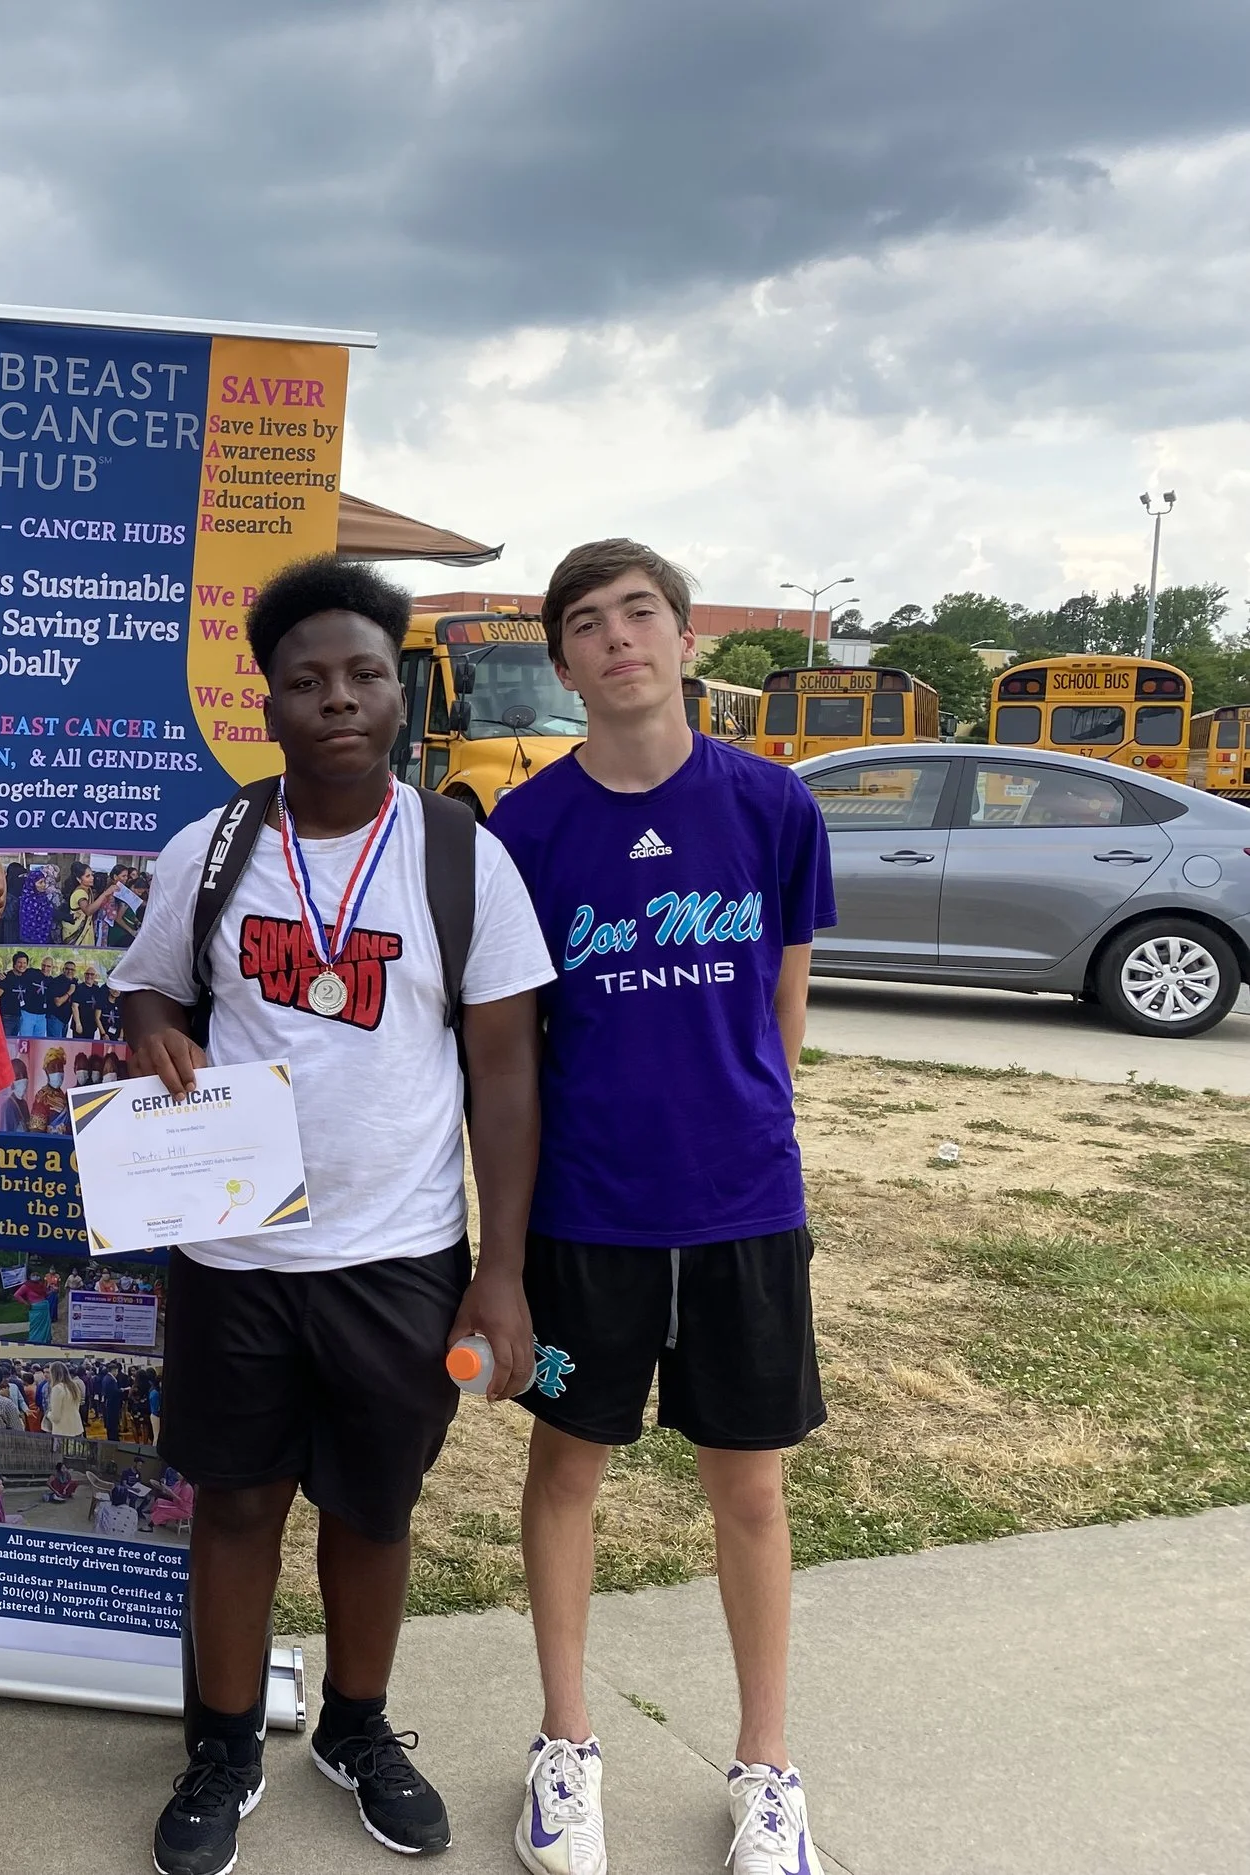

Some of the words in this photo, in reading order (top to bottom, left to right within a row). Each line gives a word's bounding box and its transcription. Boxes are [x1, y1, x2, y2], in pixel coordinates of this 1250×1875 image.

[0, 352, 188, 401] BREAST
[221, 375, 325, 408] SAVER
[209, 415, 254, 435] Save
[259, 417, 307, 438] lives
[313, 419, 338, 444] by
[205, 440, 316, 462] Awareness
[204, 464, 337, 492] Volunteering
[202, 489, 306, 511] Education
[19, 517, 117, 542] CANCER
[122, 522, 186, 545] HUBS
[199, 513, 293, 534] Research
[21, 569, 185, 603] Sustainable
[195, 584, 235, 607] We
[2, 608, 101, 646] Saving
[106, 613, 180, 642] Lives
[199, 619, 239, 641] We
[487, 622, 547, 641] SCHOOL
[800, 675, 844, 689] SCHOOL
[850, 675, 872, 689] BUS
[1053, 673, 1100, 689] SCHOOL
[1104, 673, 1130, 689] BUS
[194, 686, 234, 708] We
[64, 717, 157, 739] CANCER
[163, 720, 186, 740] in
[29, 748, 46, 767] &
[51, 748, 81, 767] All
[87, 749, 203, 772] GENDERS.
[83, 780, 161, 803] against
[15, 809, 46, 828] OF
[51, 810, 157, 832] CANCERS
[203, 799, 250, 890] HEAD
[629, 844, 673, 859] adidas
[563, 904, 638, 971] Cox
[646, 890, 763, 946] Mill
[595, 961, 735, 994] TENNIS
[322, 984, 334, 1000] 2
[131, 1086, 232, 1113] CERTICATE
[134, 1112, 147, 1120] OF
[44, 1150, 63, 1172] a
[0, 1174, 67, 1198] bridge
[27, 1199, 59, 1217] the
[36, 1222, 87, 1242] Deve
[7, 1534, 23, 1546] All
[26, 1538, 46, 1548] our
[48, 1540, 94, 1554] services
[97, 1546, 115, 1556] are
[118, 1546, 141, 1559] free
[143, 1551, 157, 1562] of
[158, 1554, 182, 1565] cost
[39, 1554, 80, 1569] strictly
[82, 1557, 120, 1572] driven
[122, 1565, 169, 1579] towards
[2, 1586, 49, 1602] 501(c)(3)
[52, 1592, 109, 1607] Nonprofit
[56, 1578, 107, 1594] Platinum
[110, 1585, 161, 1601] Certified
[164, 1592, 174, 1602] &
[44, 1604, 55, 1616] in
[62, 1607, 96, 1620] North
[99, 1611, 151, 1628] Carolina,
[154, 1618, 182, 1632] USA,
